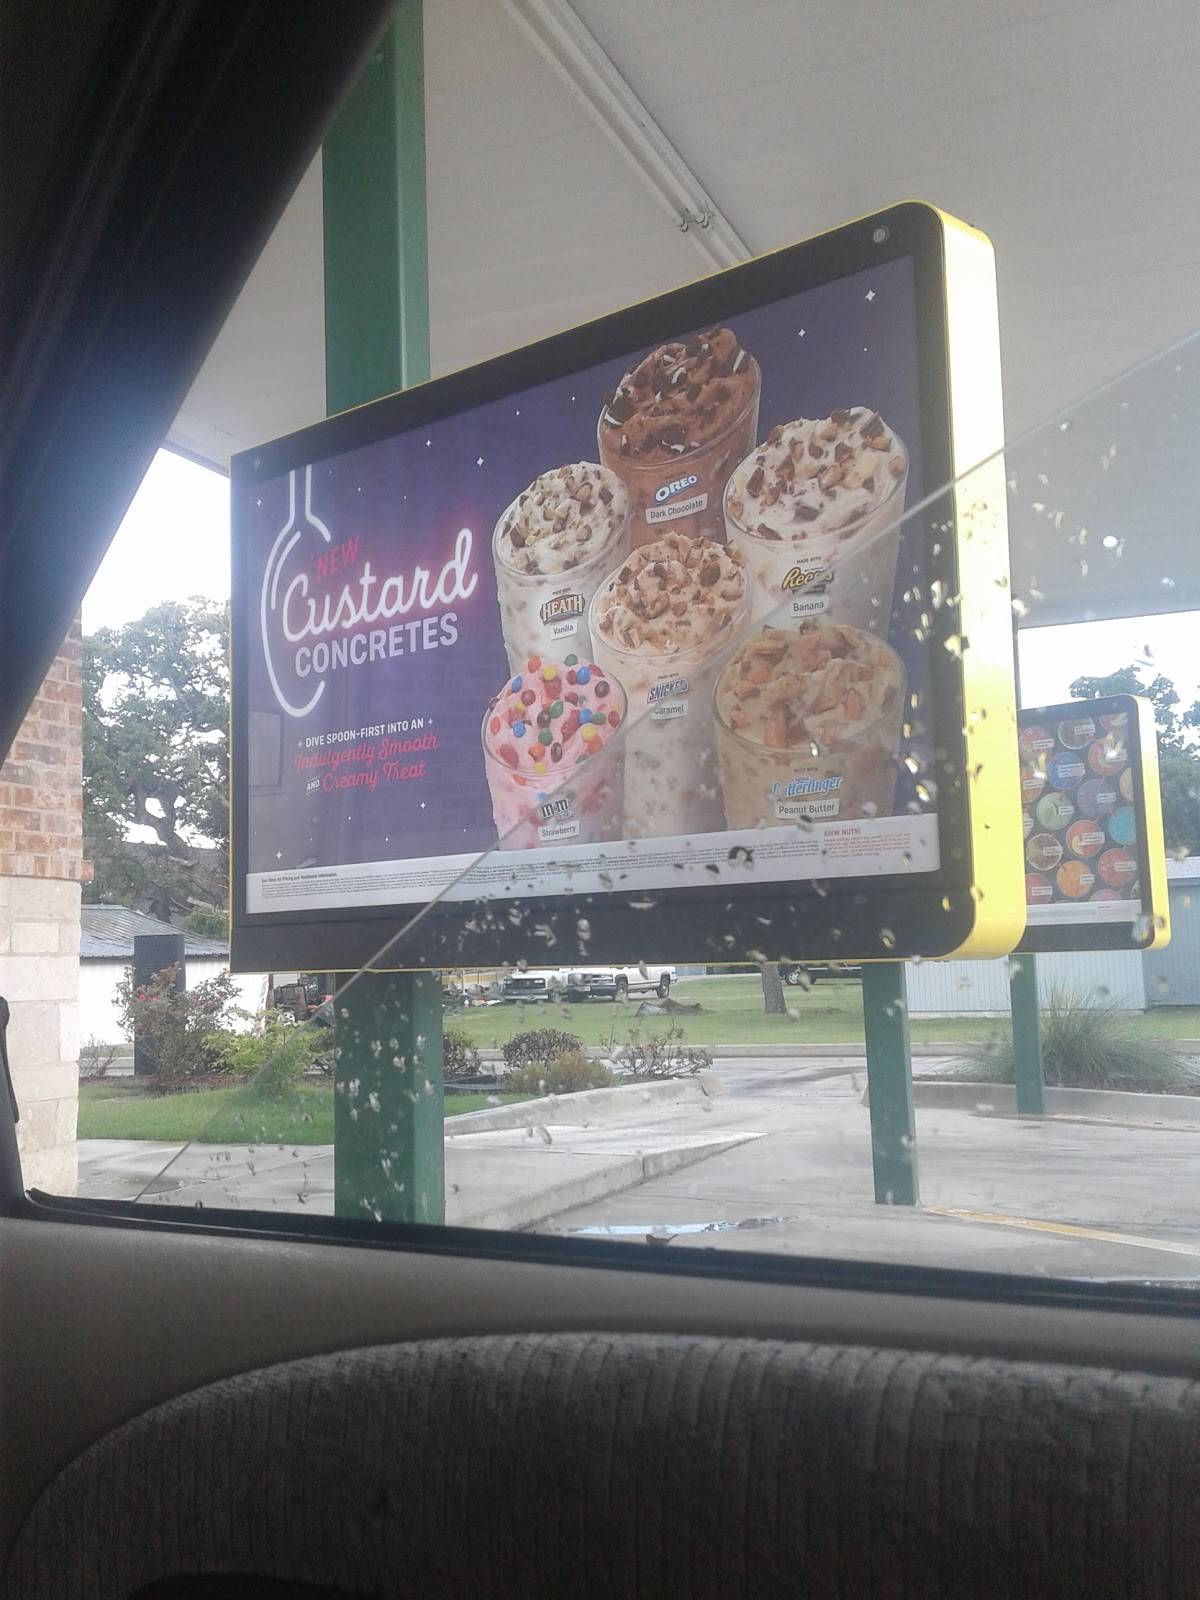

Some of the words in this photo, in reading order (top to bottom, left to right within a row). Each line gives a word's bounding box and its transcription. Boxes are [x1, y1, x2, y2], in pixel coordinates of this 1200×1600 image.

[655, 475, 698, 501] OREO
[650, 509, 666, 519] Dark
[667, 499, 703, 516] Chocolate
[316, 536, 360, 578] NEW
[282, 528, 478, 642] Custard
[543, 594, 583, 622] HEATH
[793, 602, 824, 612] Banana
[553, 623, 574, 635] Vanilla
[295, 612, 458, 677] CONCRETES
[305, 735, 325, 748] DIVE
[326, 724, 386, 745] SPOON-FIRST
[387, 720, 409, 734] INTO
[410, 717, 424, 730] AN
[294, 740, 375, 771] Indulgently
[378, 732, 439, 760] Smooth
[306, 779, 320, 791] AND
[322, 769, 378, 792] Creamy
[383, 760, 426, 781] Treat
[779, 805, 806, 814] Peanut
[809, 803, 836, 814] Butter
[541, 826, 576, 837] Strawberry
